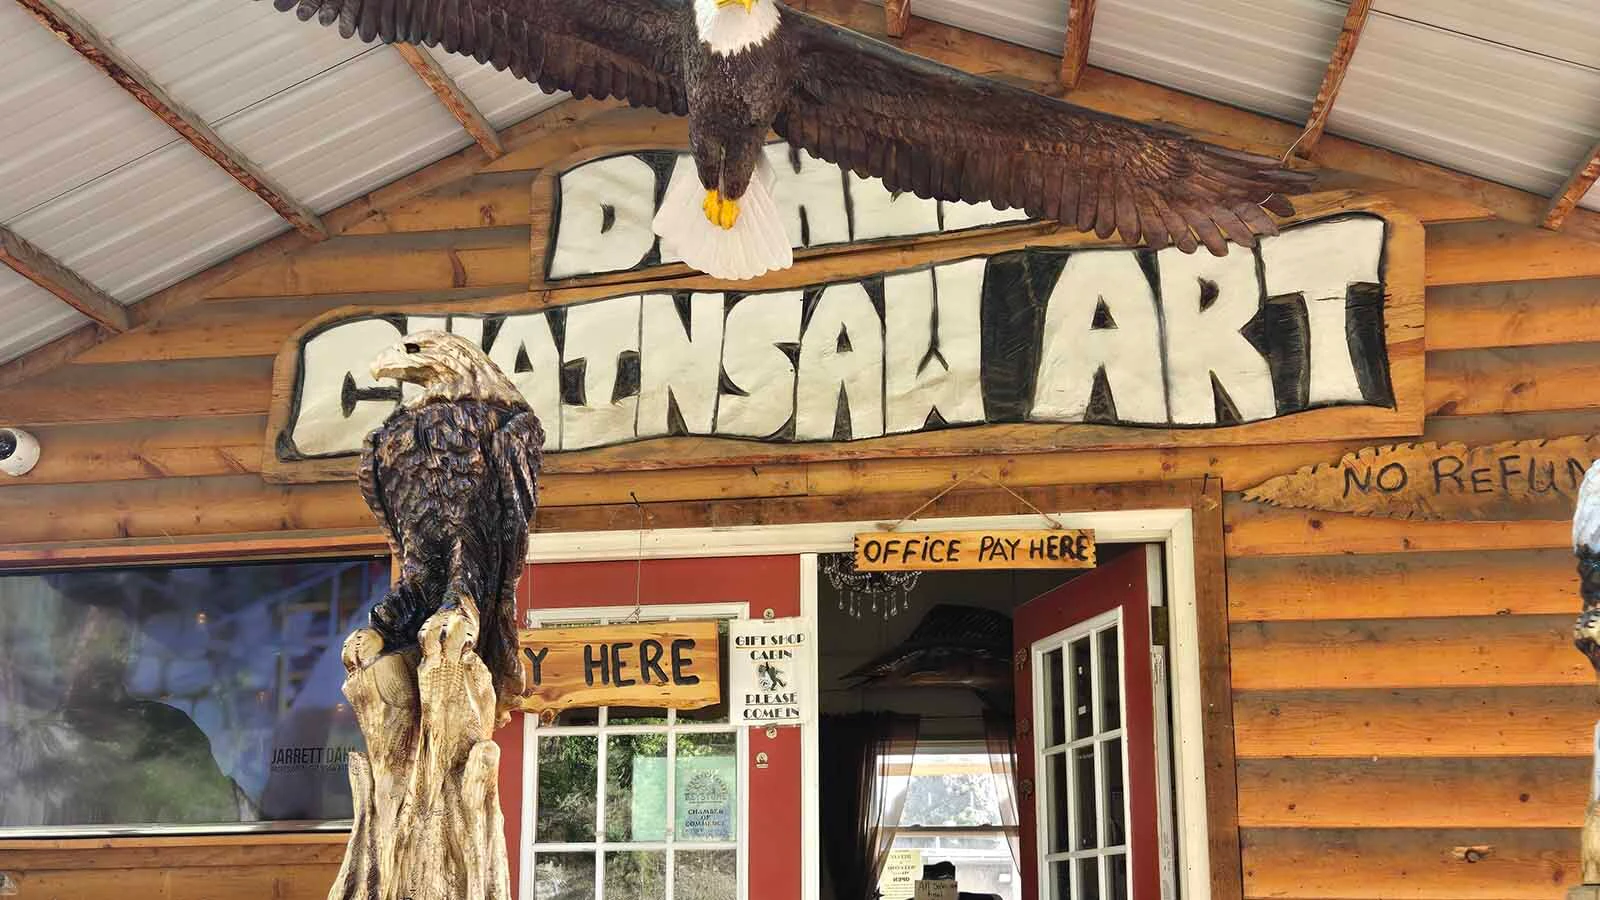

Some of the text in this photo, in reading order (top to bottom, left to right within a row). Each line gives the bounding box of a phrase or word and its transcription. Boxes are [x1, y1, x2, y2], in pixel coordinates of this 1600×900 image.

[290, 216, 1384, 456] CAINSAW ART
[1342, 462, 1409, 498] NO
[978, 535, 1021, 562] PAY
[1029, 535, 1089, 561] HERE
[735, 633, 805, 646] GIFT SHOP
[583, 638, 700, 687] HERE
[750, 649, 793, 660] CABIN
[745, 692, 798, 704] PLEASE
[743, 707, 800, 718] COME IN
[271, 747, 323, 764] JARRETT
